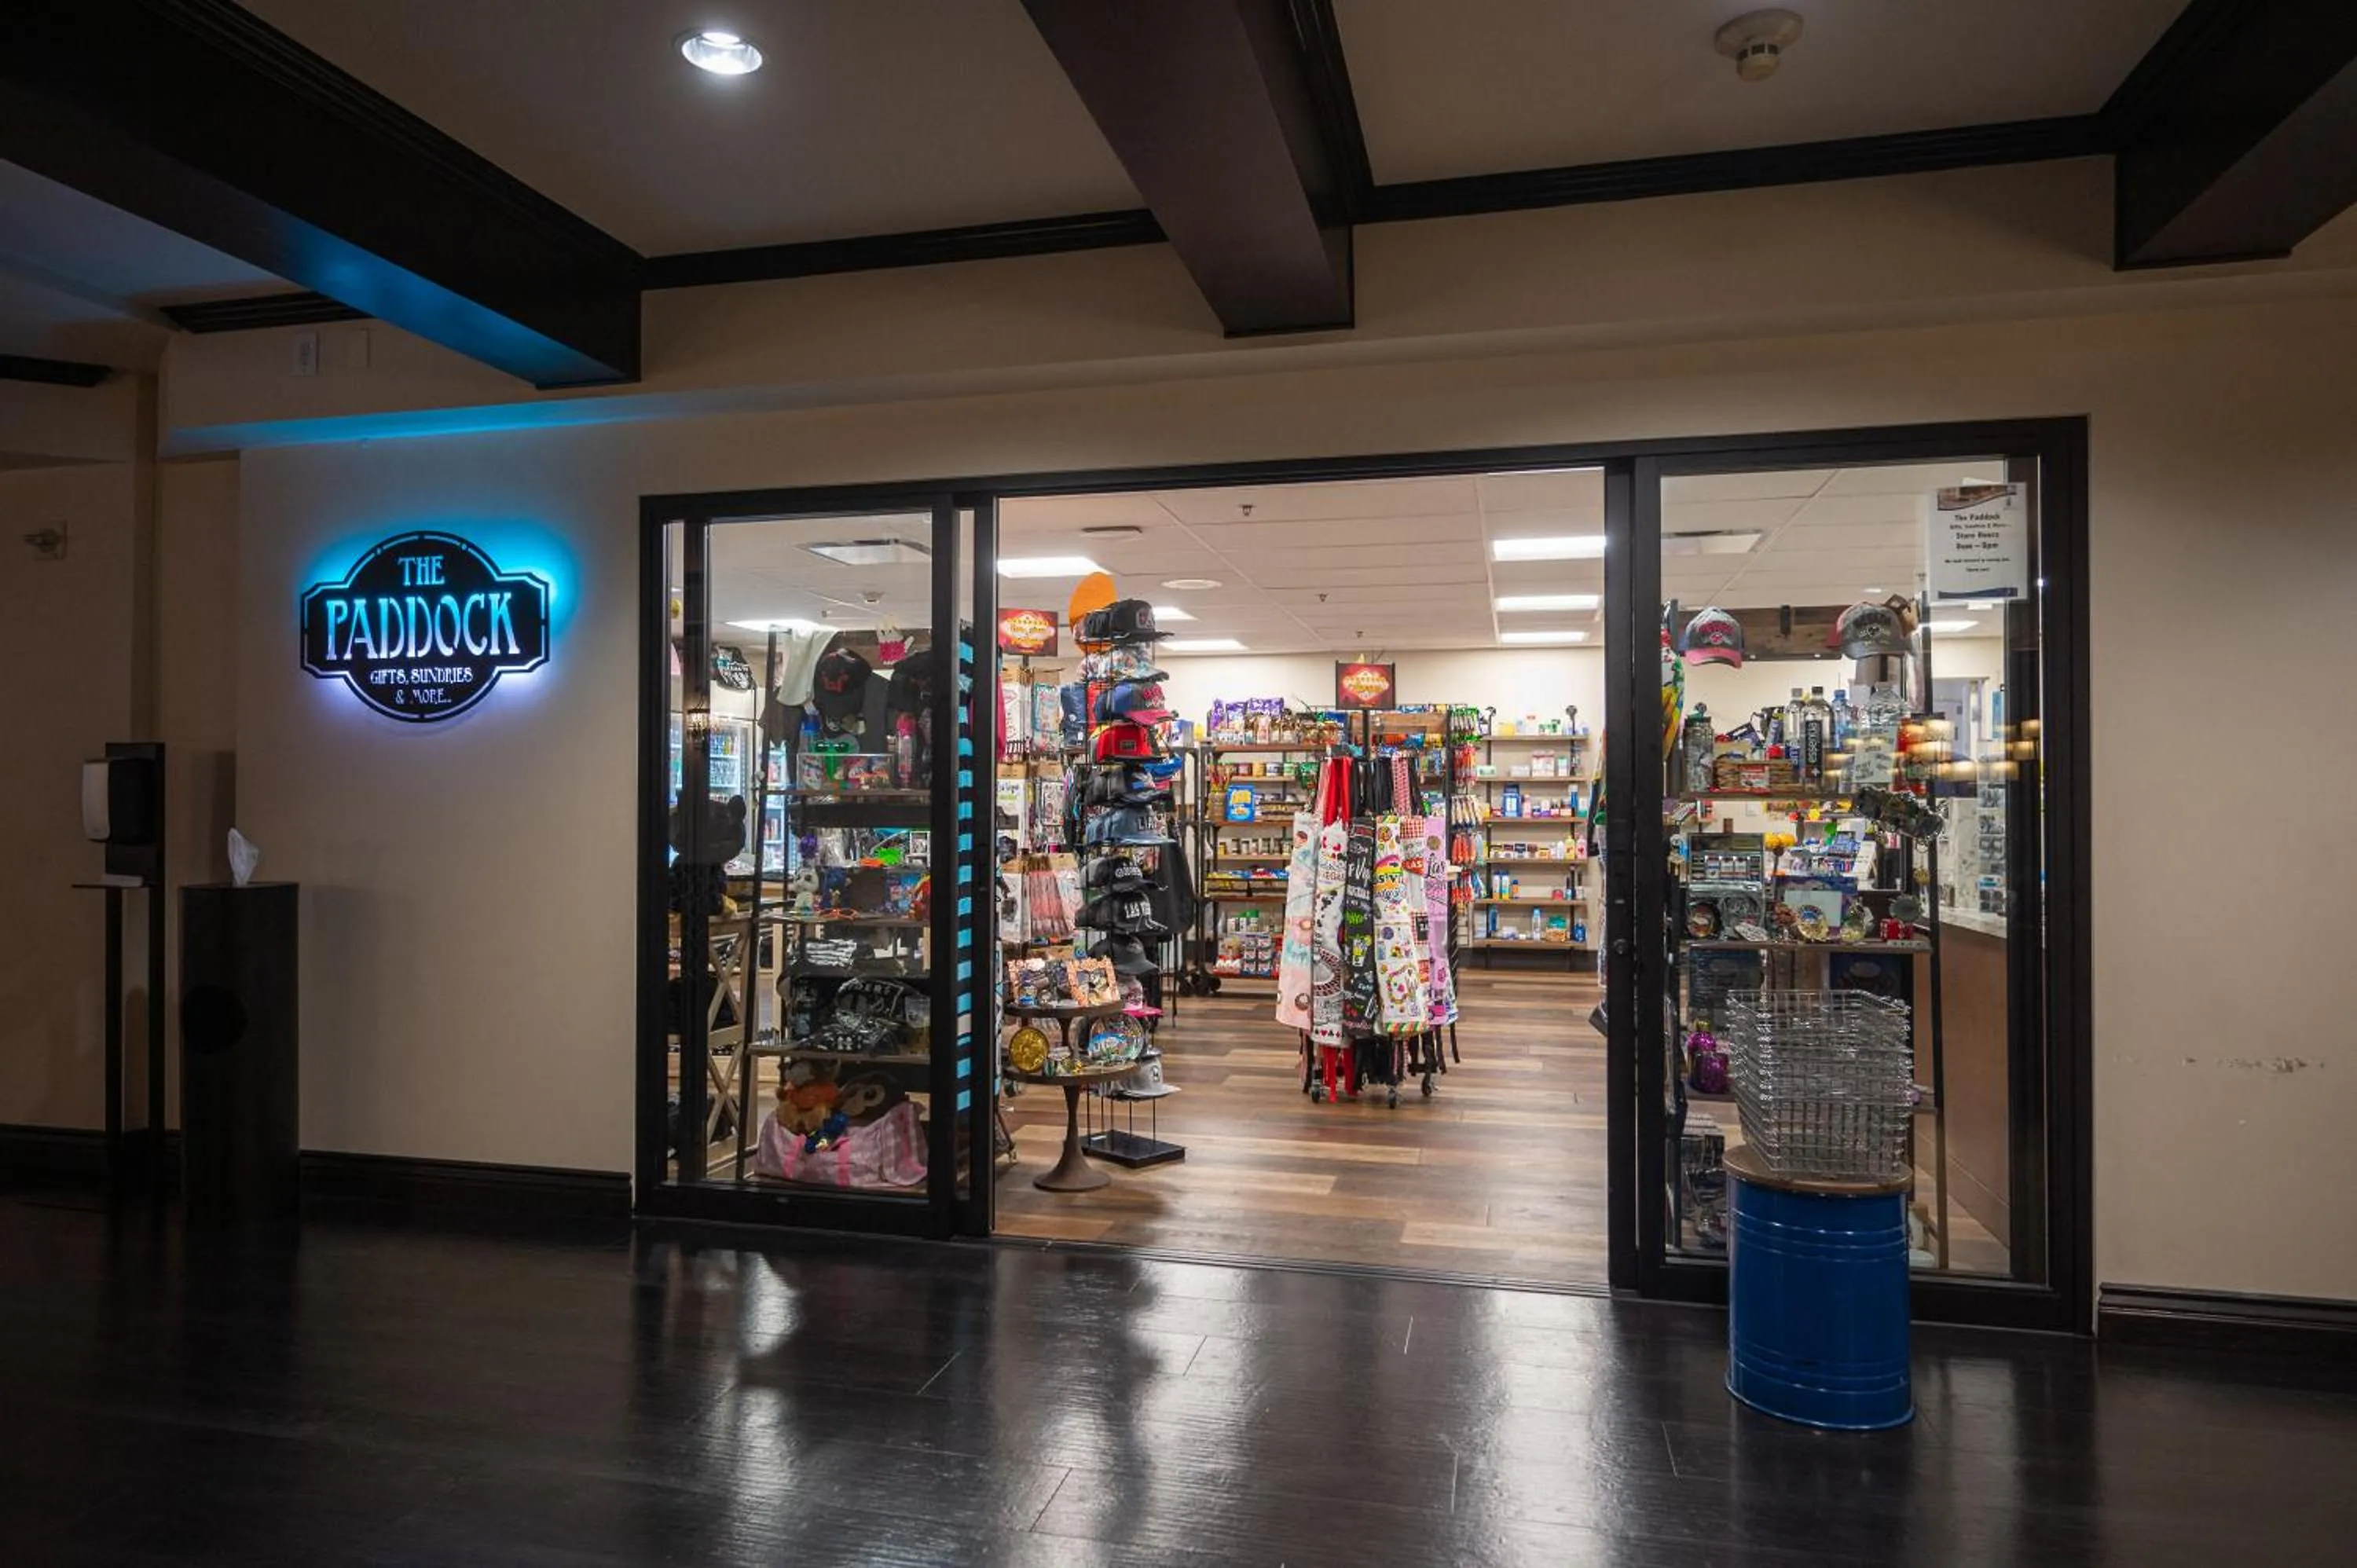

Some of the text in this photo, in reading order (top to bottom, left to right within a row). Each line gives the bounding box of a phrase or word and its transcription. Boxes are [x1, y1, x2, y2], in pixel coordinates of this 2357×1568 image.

[398, 555, 445, 586] THE
[325, 592, 521, 661] PADDOCK
[370, 667, 473, 685] GIFTS, SUNDRIES
[395, 689, 405, 705] &
